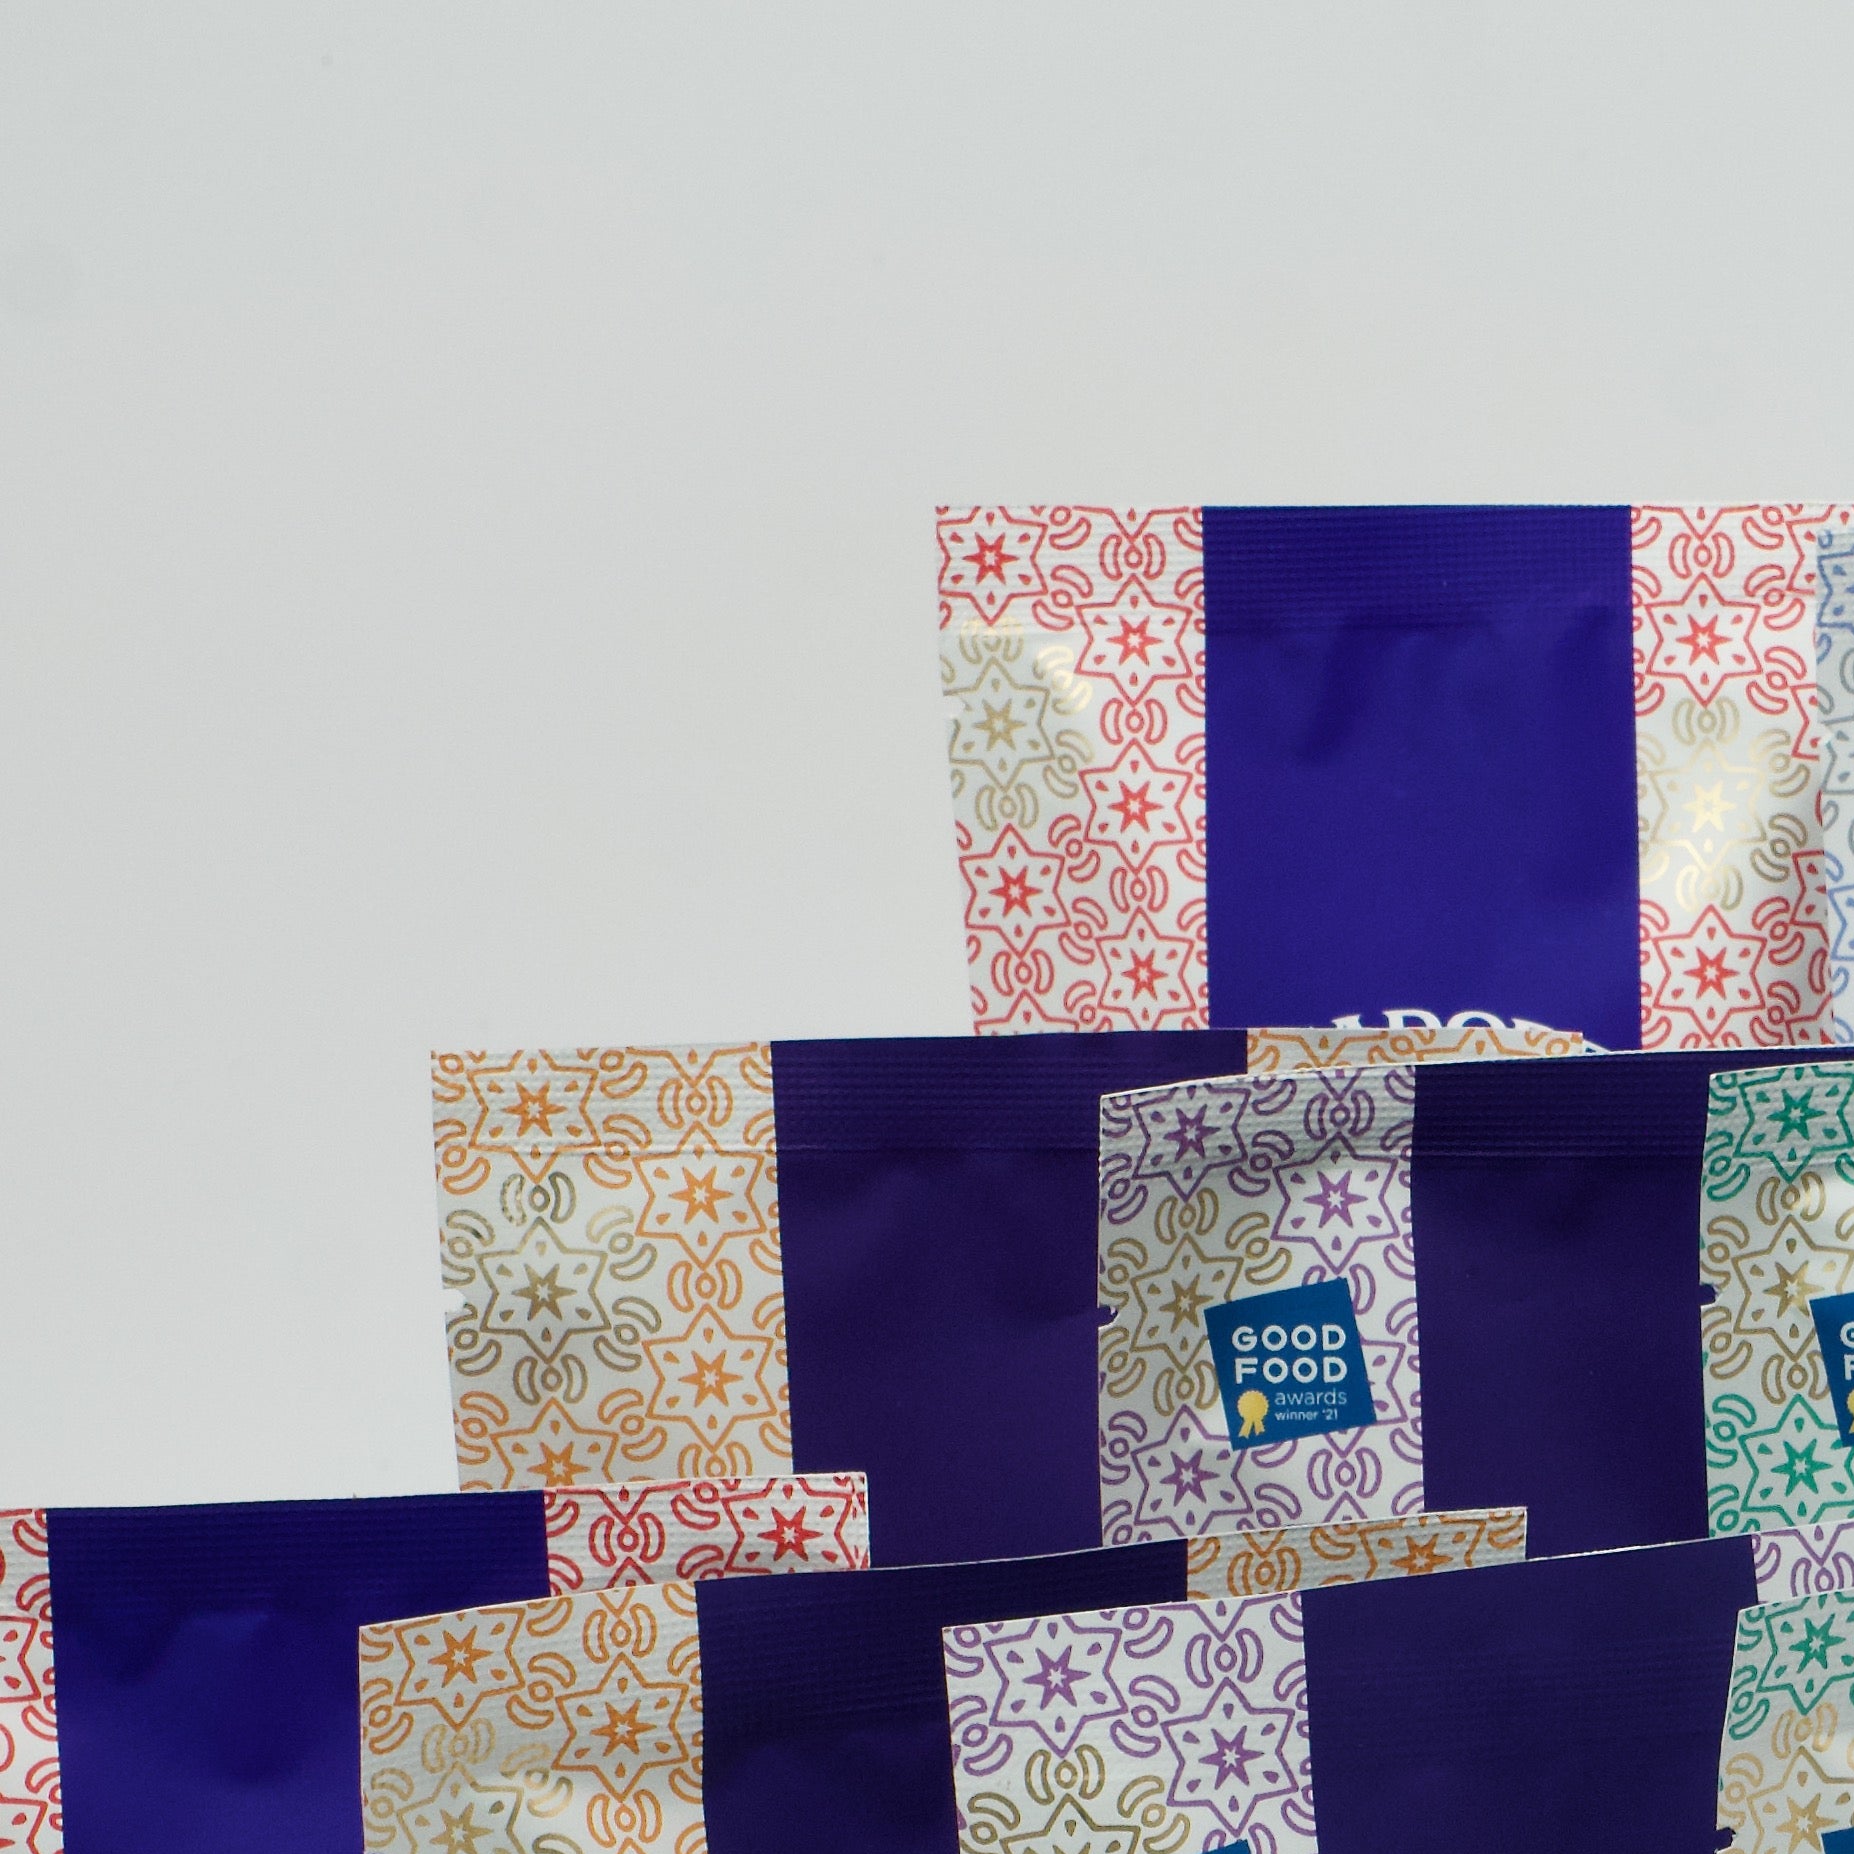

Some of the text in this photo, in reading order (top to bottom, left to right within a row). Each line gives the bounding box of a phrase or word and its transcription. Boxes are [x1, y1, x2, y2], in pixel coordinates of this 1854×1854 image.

[1232, 1324, 1346, 1351] GOOD
[1235, 1357, 1347, 1384] FOOD
[1275, 1389, 1346, 1405] awards
[1275, 1409, 1318, 1421] winner
